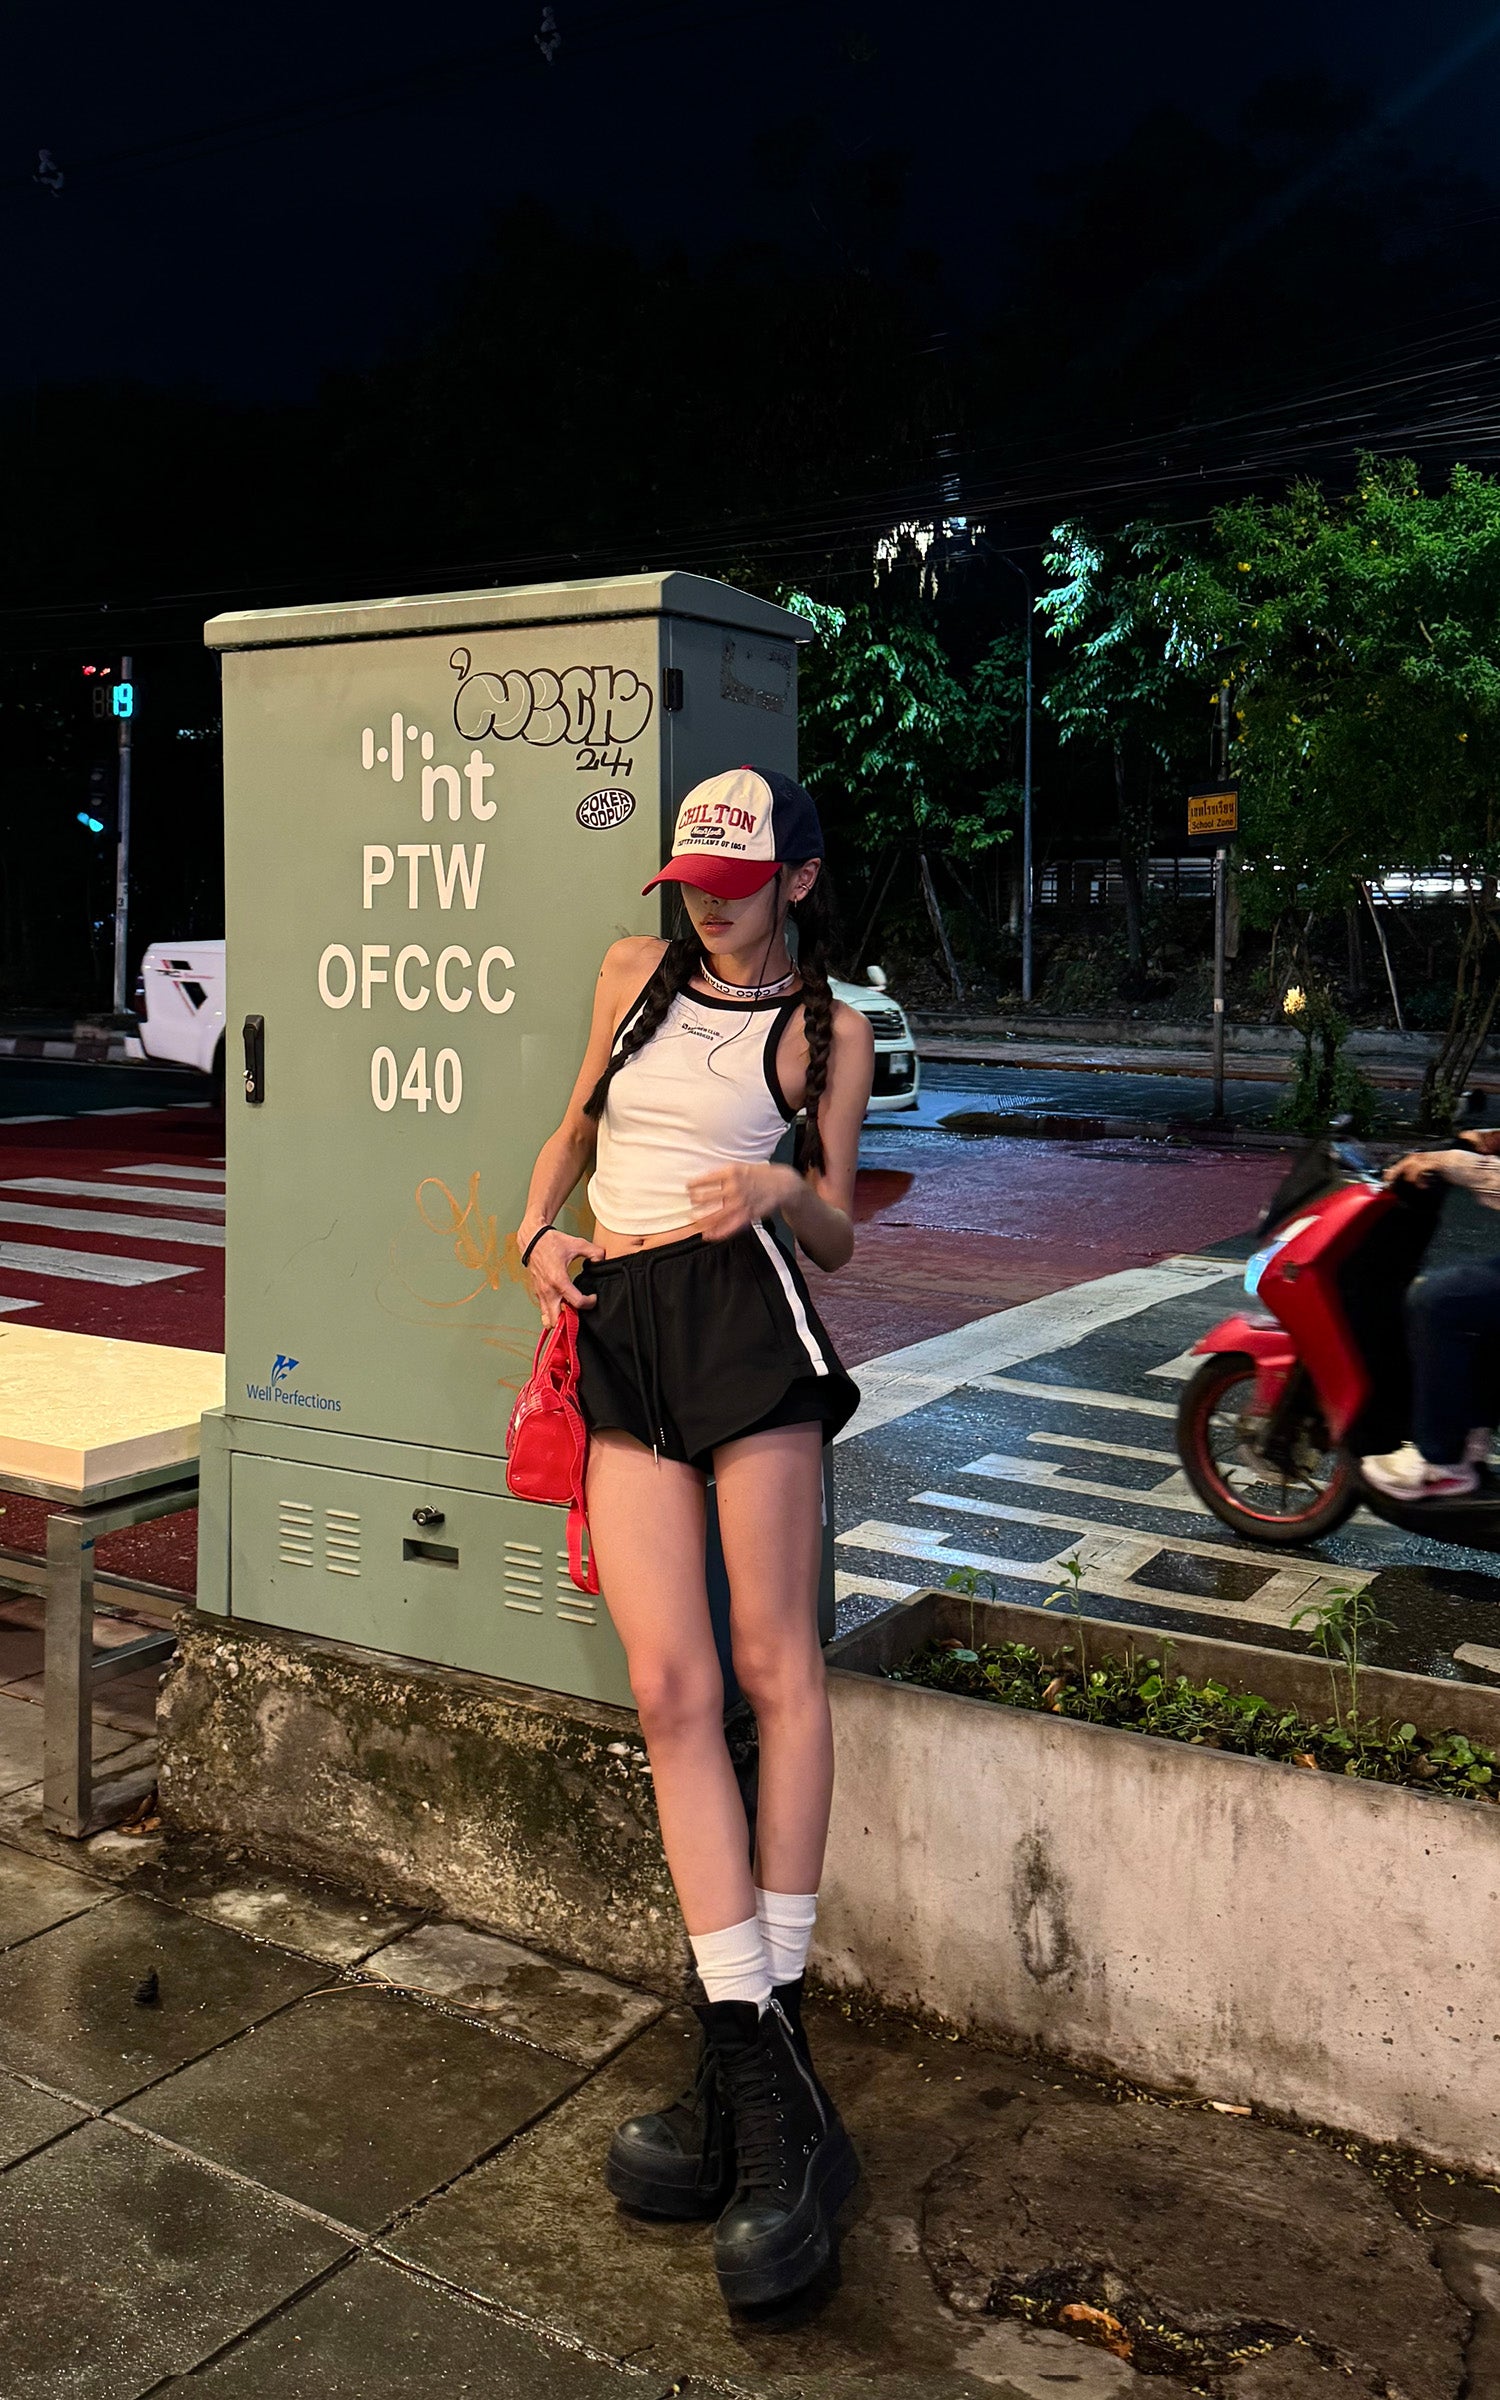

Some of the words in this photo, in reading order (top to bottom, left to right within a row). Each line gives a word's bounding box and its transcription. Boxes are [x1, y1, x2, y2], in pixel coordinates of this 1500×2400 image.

[581, 791, 630, 815] POKER
[678, 803, 757, 833] CHILTON
[1192, 819, 1214, 830] School
[1216, 818, 1234, 827] Zone
[363, 843, 486, 909] PTW
[318, 943, 516, 1015] OFCCC
[736, 989, 771, 998] COCO
[370, 1046, 463, 1114] 040
[246, 1383, 272, 1401] Well
[274, 1387, 342, 1412] Perfections
